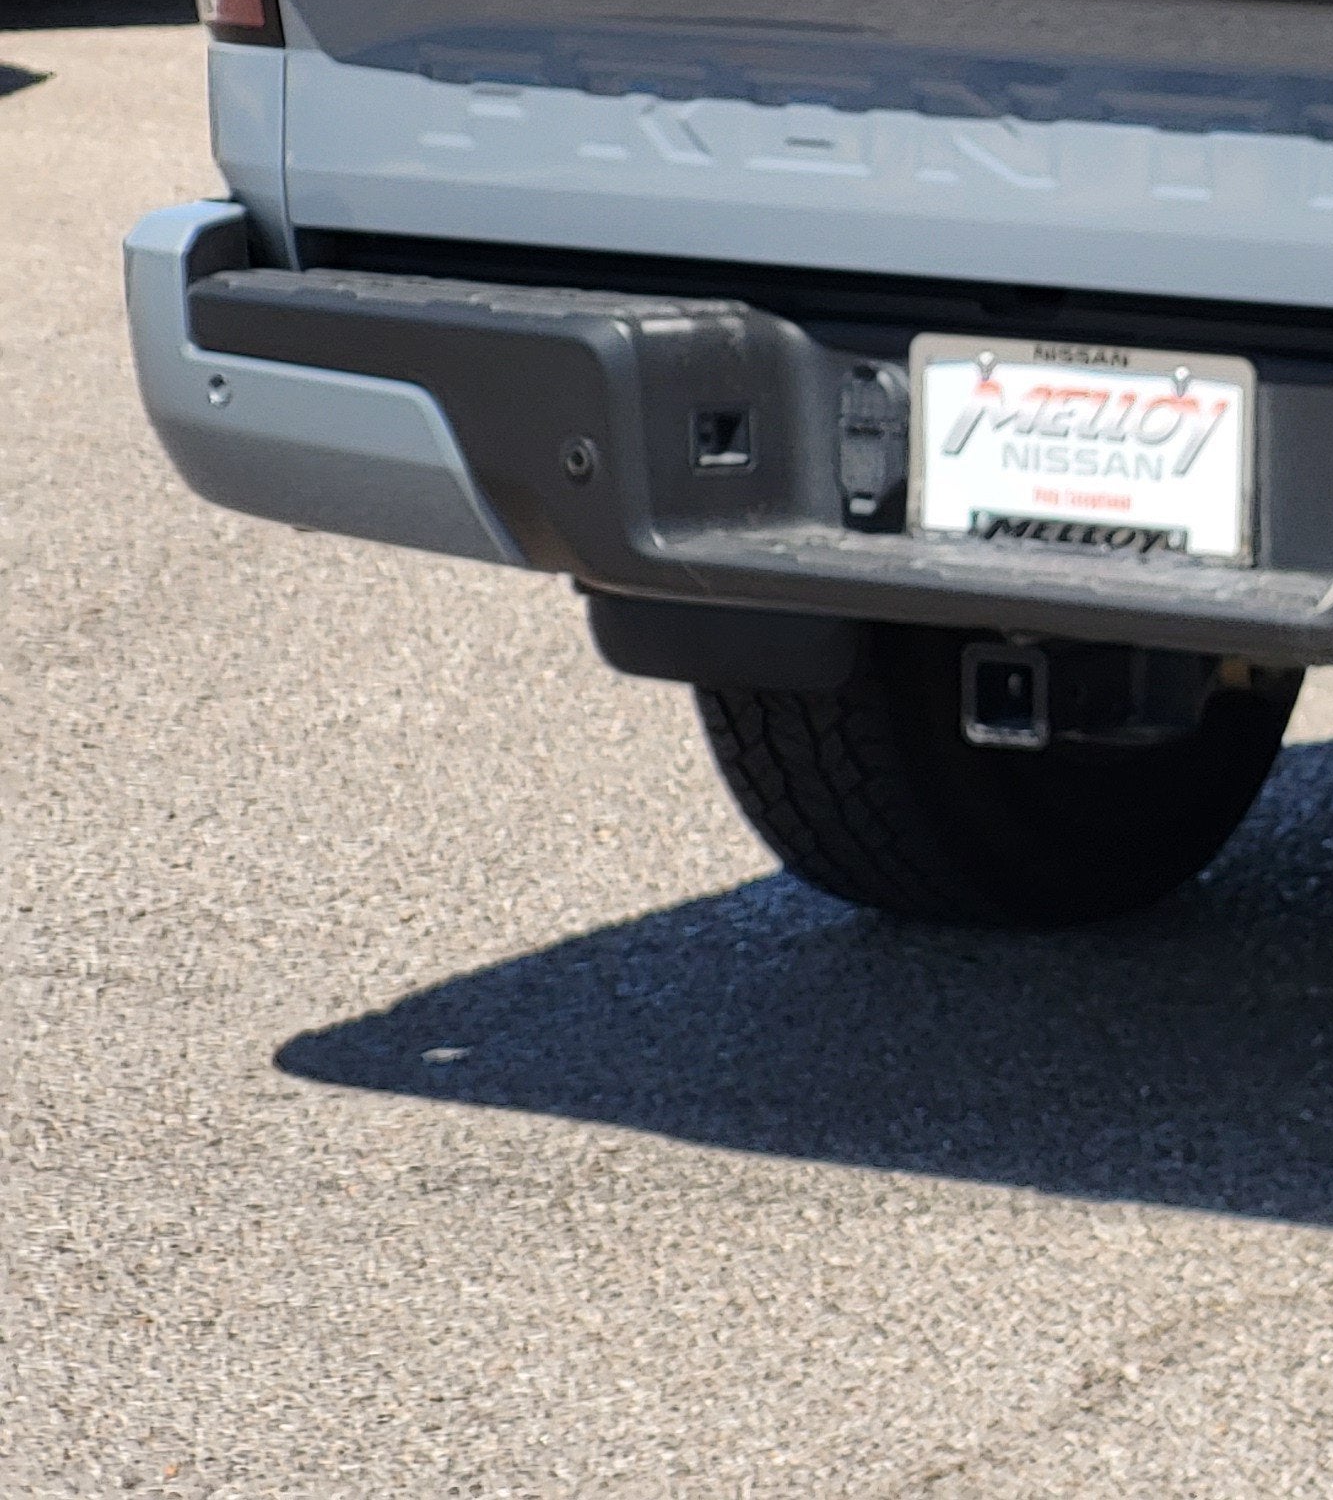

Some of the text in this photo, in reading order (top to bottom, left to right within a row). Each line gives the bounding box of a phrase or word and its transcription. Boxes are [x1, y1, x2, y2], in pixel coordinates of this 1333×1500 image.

[1034, 344, 1129, 368] NISSAN
[942, 379, 1228, 477] MELLOY
[1001, 441, 1164, 482] NISSAN
[984, 517, 1165, 553] MELLOY
